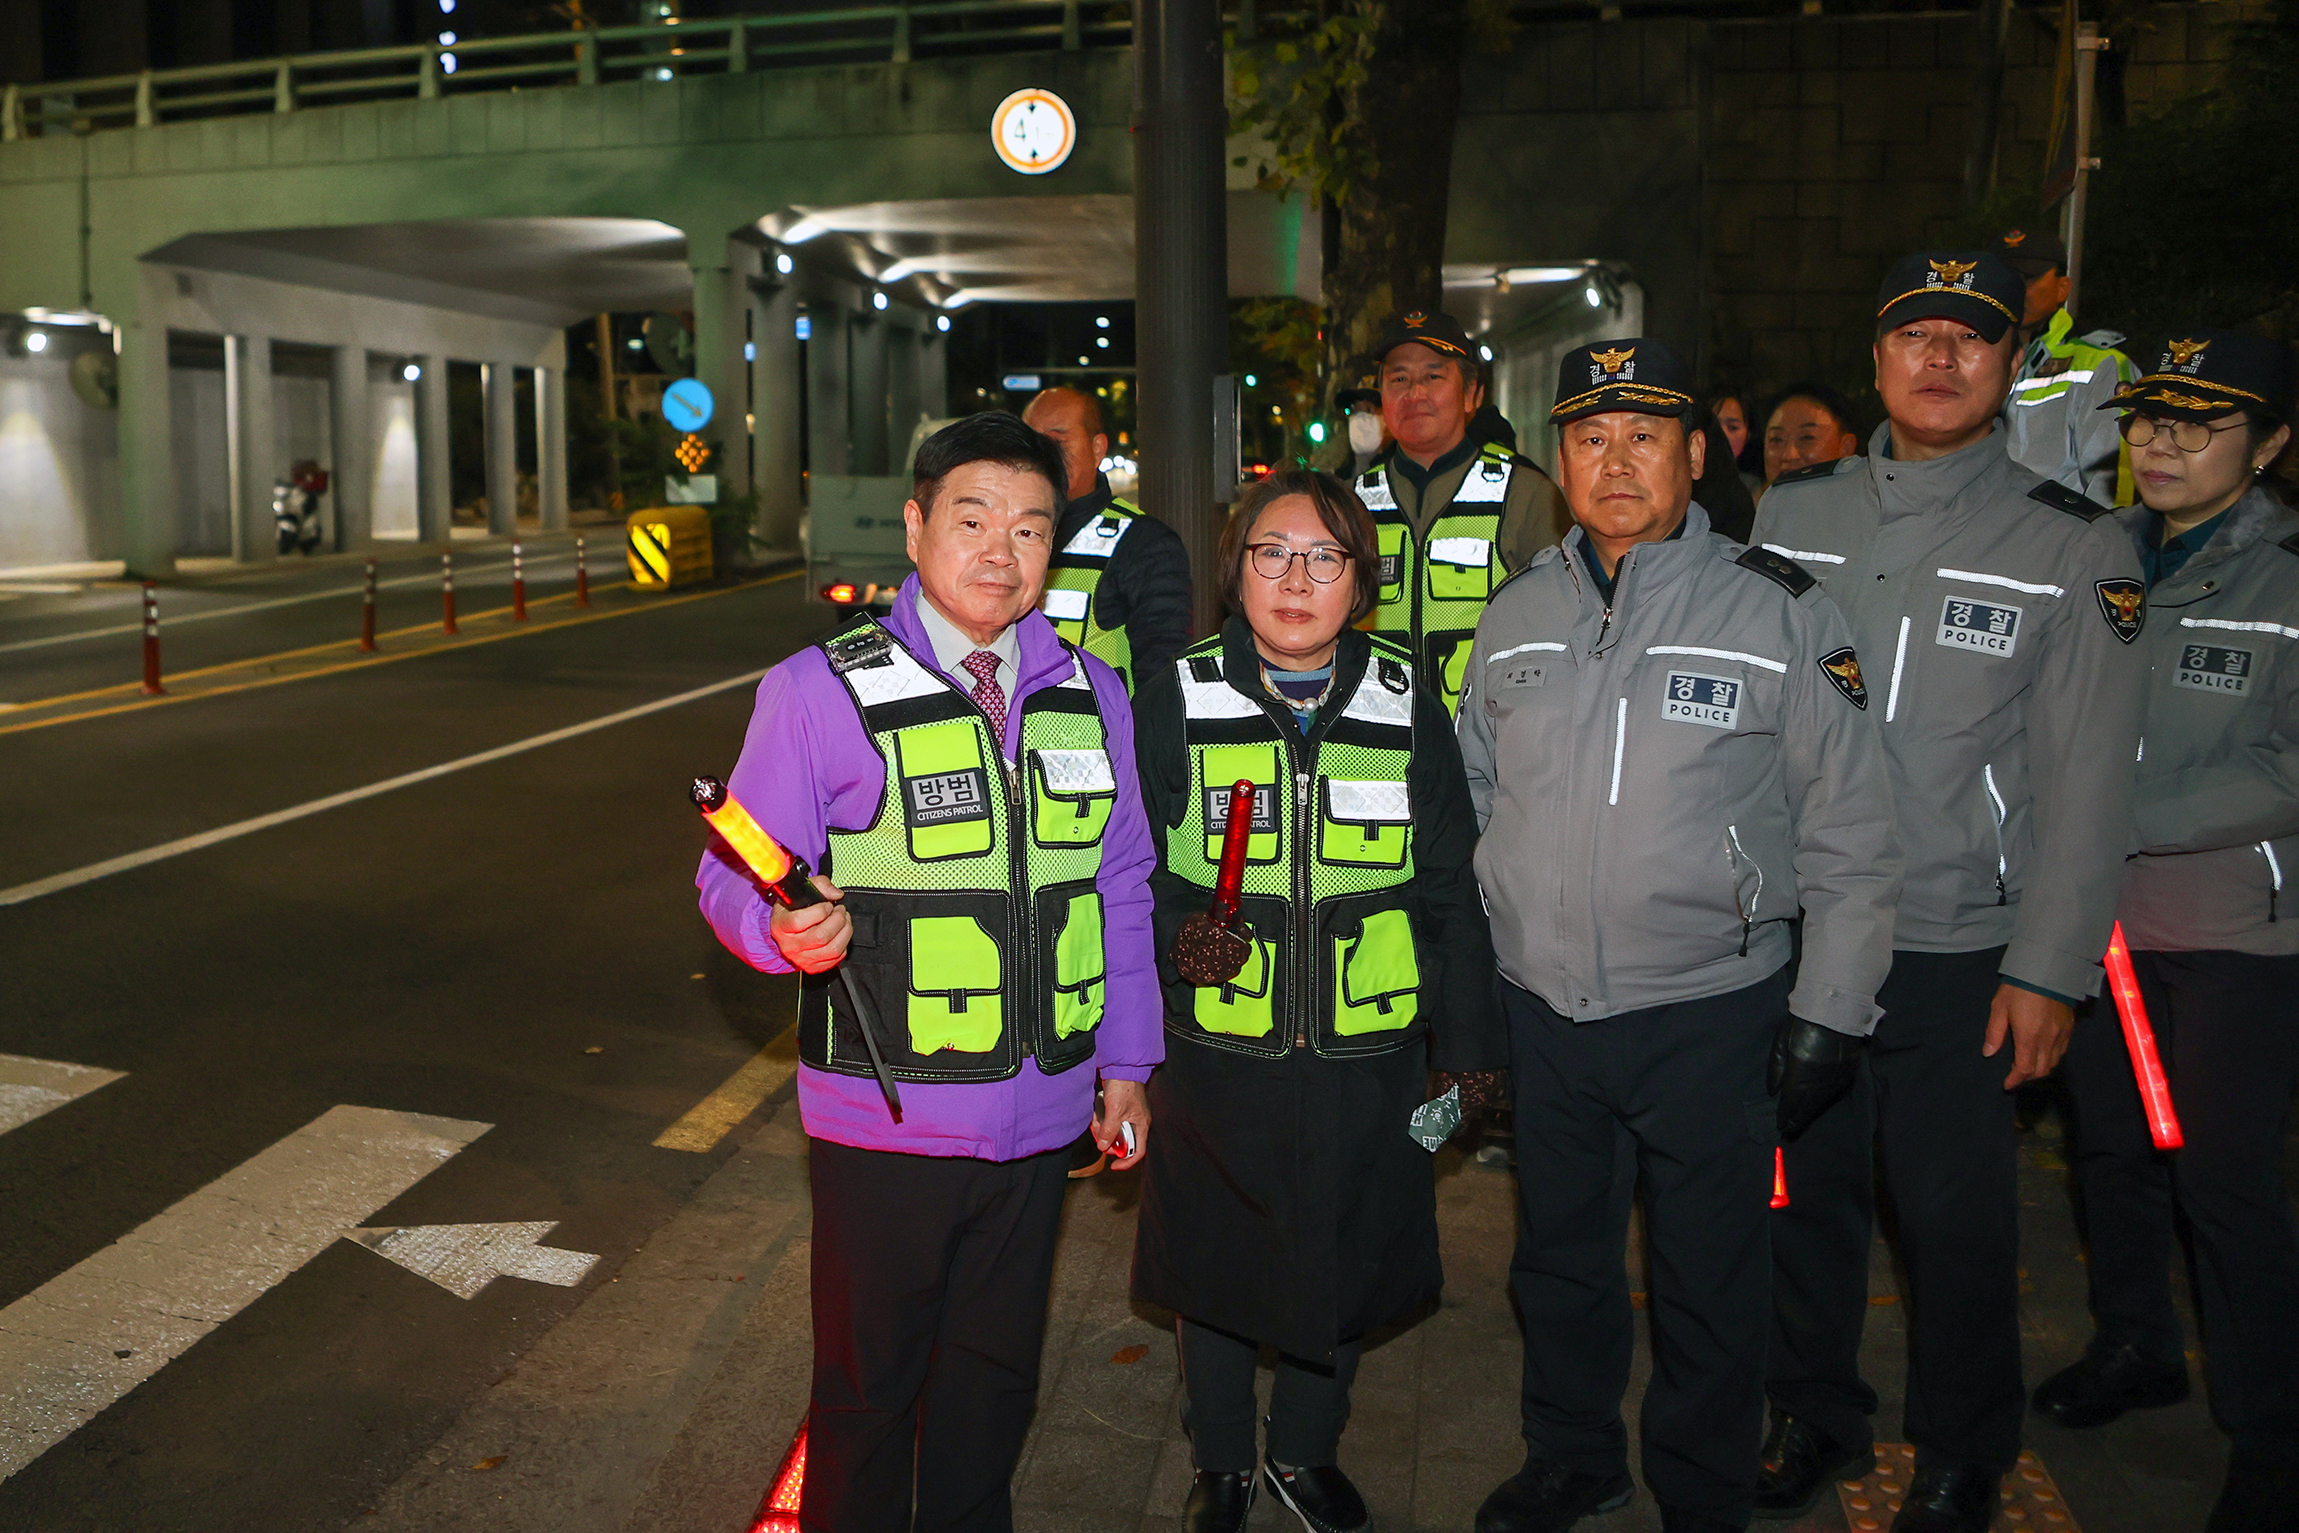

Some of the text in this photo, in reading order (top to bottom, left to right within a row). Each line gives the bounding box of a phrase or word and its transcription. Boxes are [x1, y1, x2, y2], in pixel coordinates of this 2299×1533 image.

[1944, 629, 2007, 650] POLICE
[2180, 672, 2243, 691] POLICE
[1669, 704, 1730, 723] POLICE
[918, 774, 974, 806] 방범
[917, 804, 983, 821] CITIZENS PATROL
